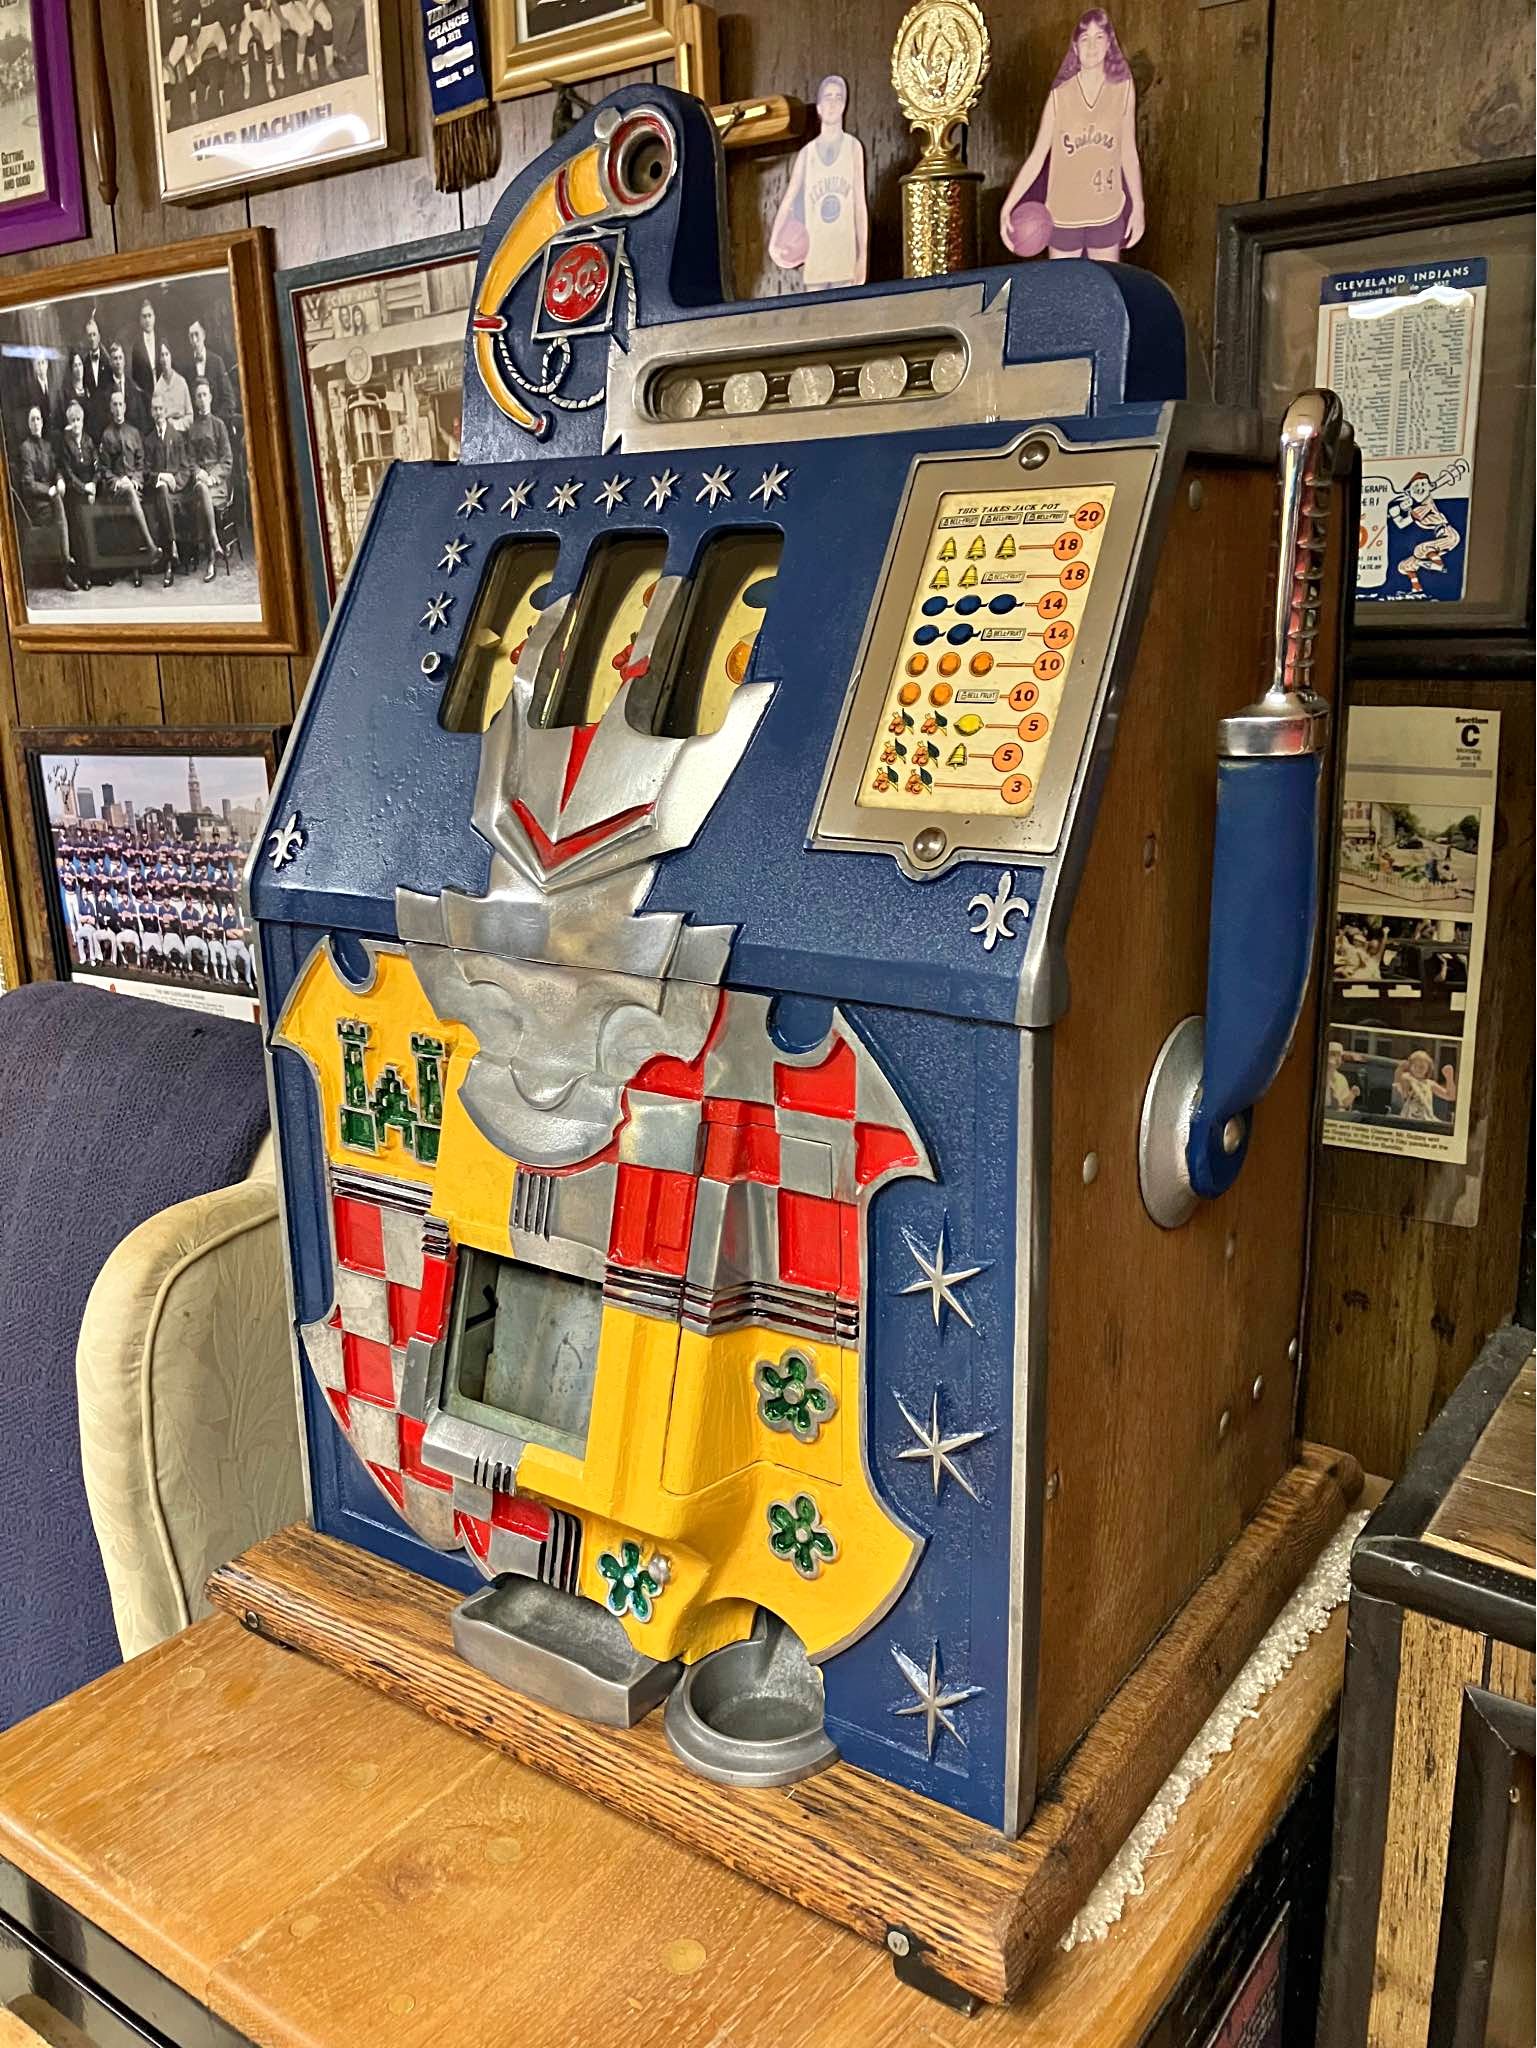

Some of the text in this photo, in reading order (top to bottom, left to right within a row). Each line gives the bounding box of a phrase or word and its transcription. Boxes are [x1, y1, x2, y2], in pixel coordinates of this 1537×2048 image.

[1063, 125, 1114, 154] Sailors
[1093, 168, 1114, 192] 44
[1335, 266, 1470, 291] CLEVELAND INDIANS
[1352, 288, 1383, 298] Baseball
[1013, 504, 1037, 512] JACK
[1078, 511, 1099, 521] 20
[1059, 539, 1078, 550] 18
[1065, 569, 1085, 580] 18
[1043, 599, 1063, 610] 14
[1049, 628, 1069, 639] 14
[1040, 659, 1060, 671] 10
[1014, 690, 1034, 701] 10
[1028, 720, 1039, 731] 5
[1456, 716, 1488, 724] Section
[1461, 725, 1480, 747] C
[1002, 750, 1013, 761] 5
[1011, 781, 1022, 792] 3
